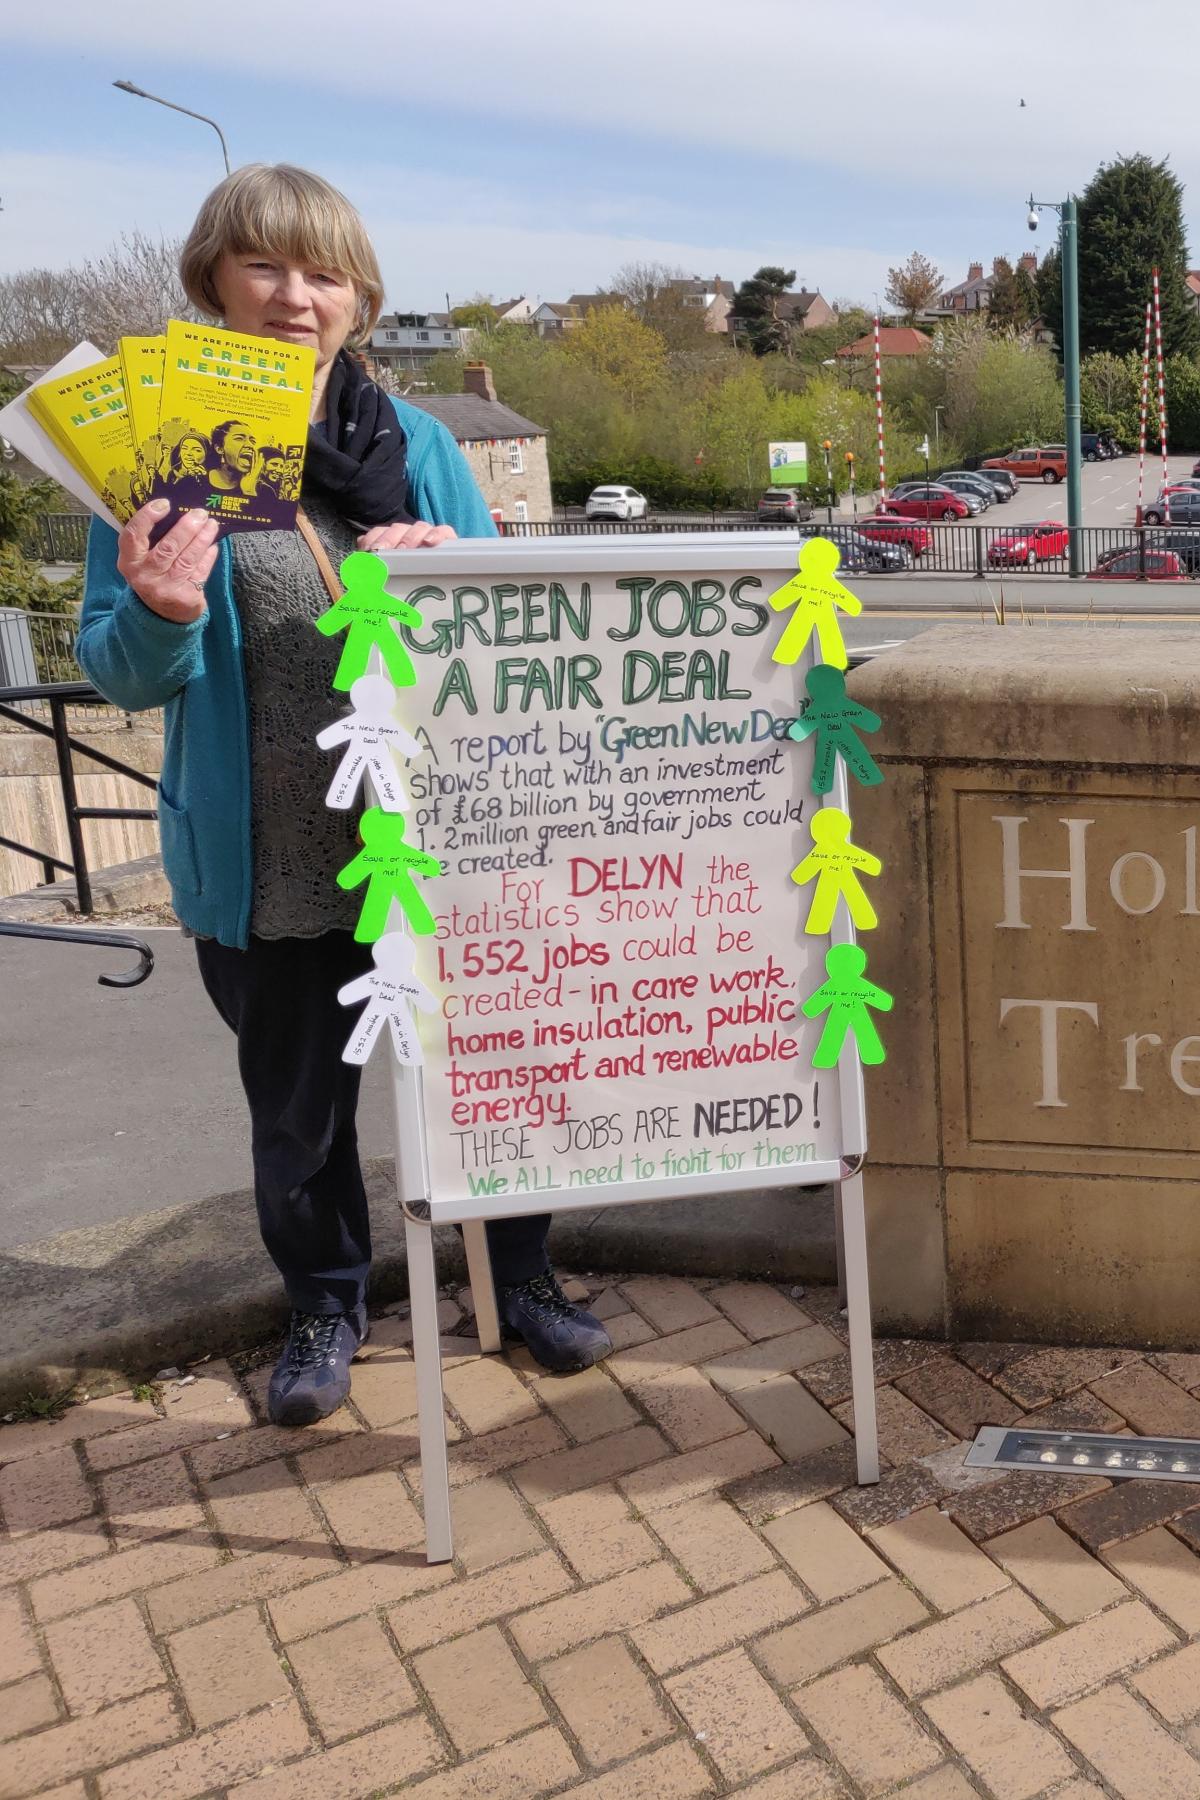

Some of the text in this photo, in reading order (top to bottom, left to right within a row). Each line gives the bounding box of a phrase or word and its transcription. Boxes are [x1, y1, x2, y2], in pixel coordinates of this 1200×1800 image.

[201, 347, 286, 372] GREEN
[202, 337, 221, 345] ARE
[225, 341, 270, 355] FIGHTING
[273, 350, 291, 359] FOR
[58, 367, 123, 396] WE ARE FIGHT
[177, 358, 304, 391] NEW DEAL
[231, 383, 249, 391] THE
[70, 398, 124, 426] NEW
[338, 605, 360, 613] Save
[400, 576, 770, 658] GREEN JOBS
[432, 649, 752, 717] A FAIR DEAL
[405, 725, 439, 768] A
[450, 720, 548, 772] report
[558, 719, 591, 766] by
[682, 711, 749, 747] New
[409, 748, 785, 800] shows that with an investment
[415, 778, 766, 826] of £68 billion by government
[536, 821, 596, 850] green
[603, 813, 639, 835] and
[641, 809, 681, 835] fair
[681, 805, 733, 840] jobs
[744, 799, 804, 826] could
[362, 854, 384, 862] Save
[458, 848, 553, 875] created.
[501, 852, 750, 904] For DELYN the
[433, 880, 762, 940] statistics show that
[532, 932, 610, 984] jobs
[623, 923, 697, 962] could
[717, 922, 754, 954] be
[632, 974, 699, 1001] care
[710, 954, 796, 994] work,
[447, 990, 796, 1057] home insulation, public
[445, 1030, 799, 1098] transport and renewable
[451, 1092, 572, 1129] energy.
[449, 1124, 534, 1169] THESE
[553, 1113, 624, 1154] JOBS
[634, 1106, 682, 1144] ARE
[466, 1168, 508, 1197] We
[514, 1165, 561, 1193] ALL
[568, 1153, 623, 1188] need
[631, 1152, 656, 1180] to
[715, 1143, 747, 1170] for
[753, 1137, 818, 1167] them
